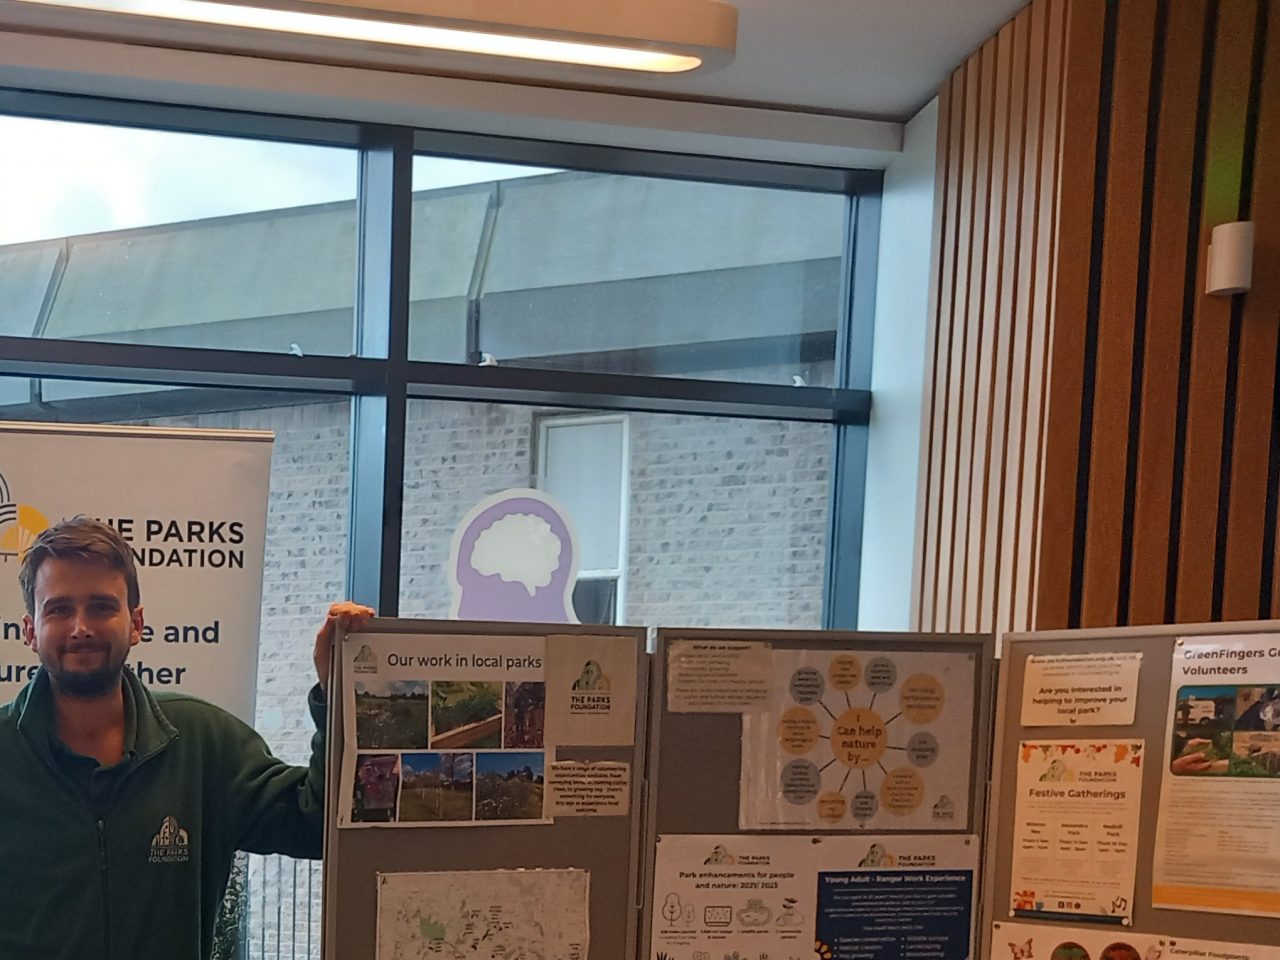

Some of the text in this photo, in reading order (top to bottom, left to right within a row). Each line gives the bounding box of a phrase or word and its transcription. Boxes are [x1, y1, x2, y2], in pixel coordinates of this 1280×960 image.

[146, 520, 243, 544] PARKS
[134, 547, 243, 568] NDATION
[164, 620, 220, 644] and
[1184, 649, 1264, 660] GreenFingers
[388, 653, 542, 671] Our work in local parks
[1183, 666, 1248, 675] Volunteers
[571, 696, 611, 704] THE PARKS
[859, 726, 882, 740] help
[841, 740, 876, 749] nature
[1029, 789, 1126, 800] Festive Gatherings
